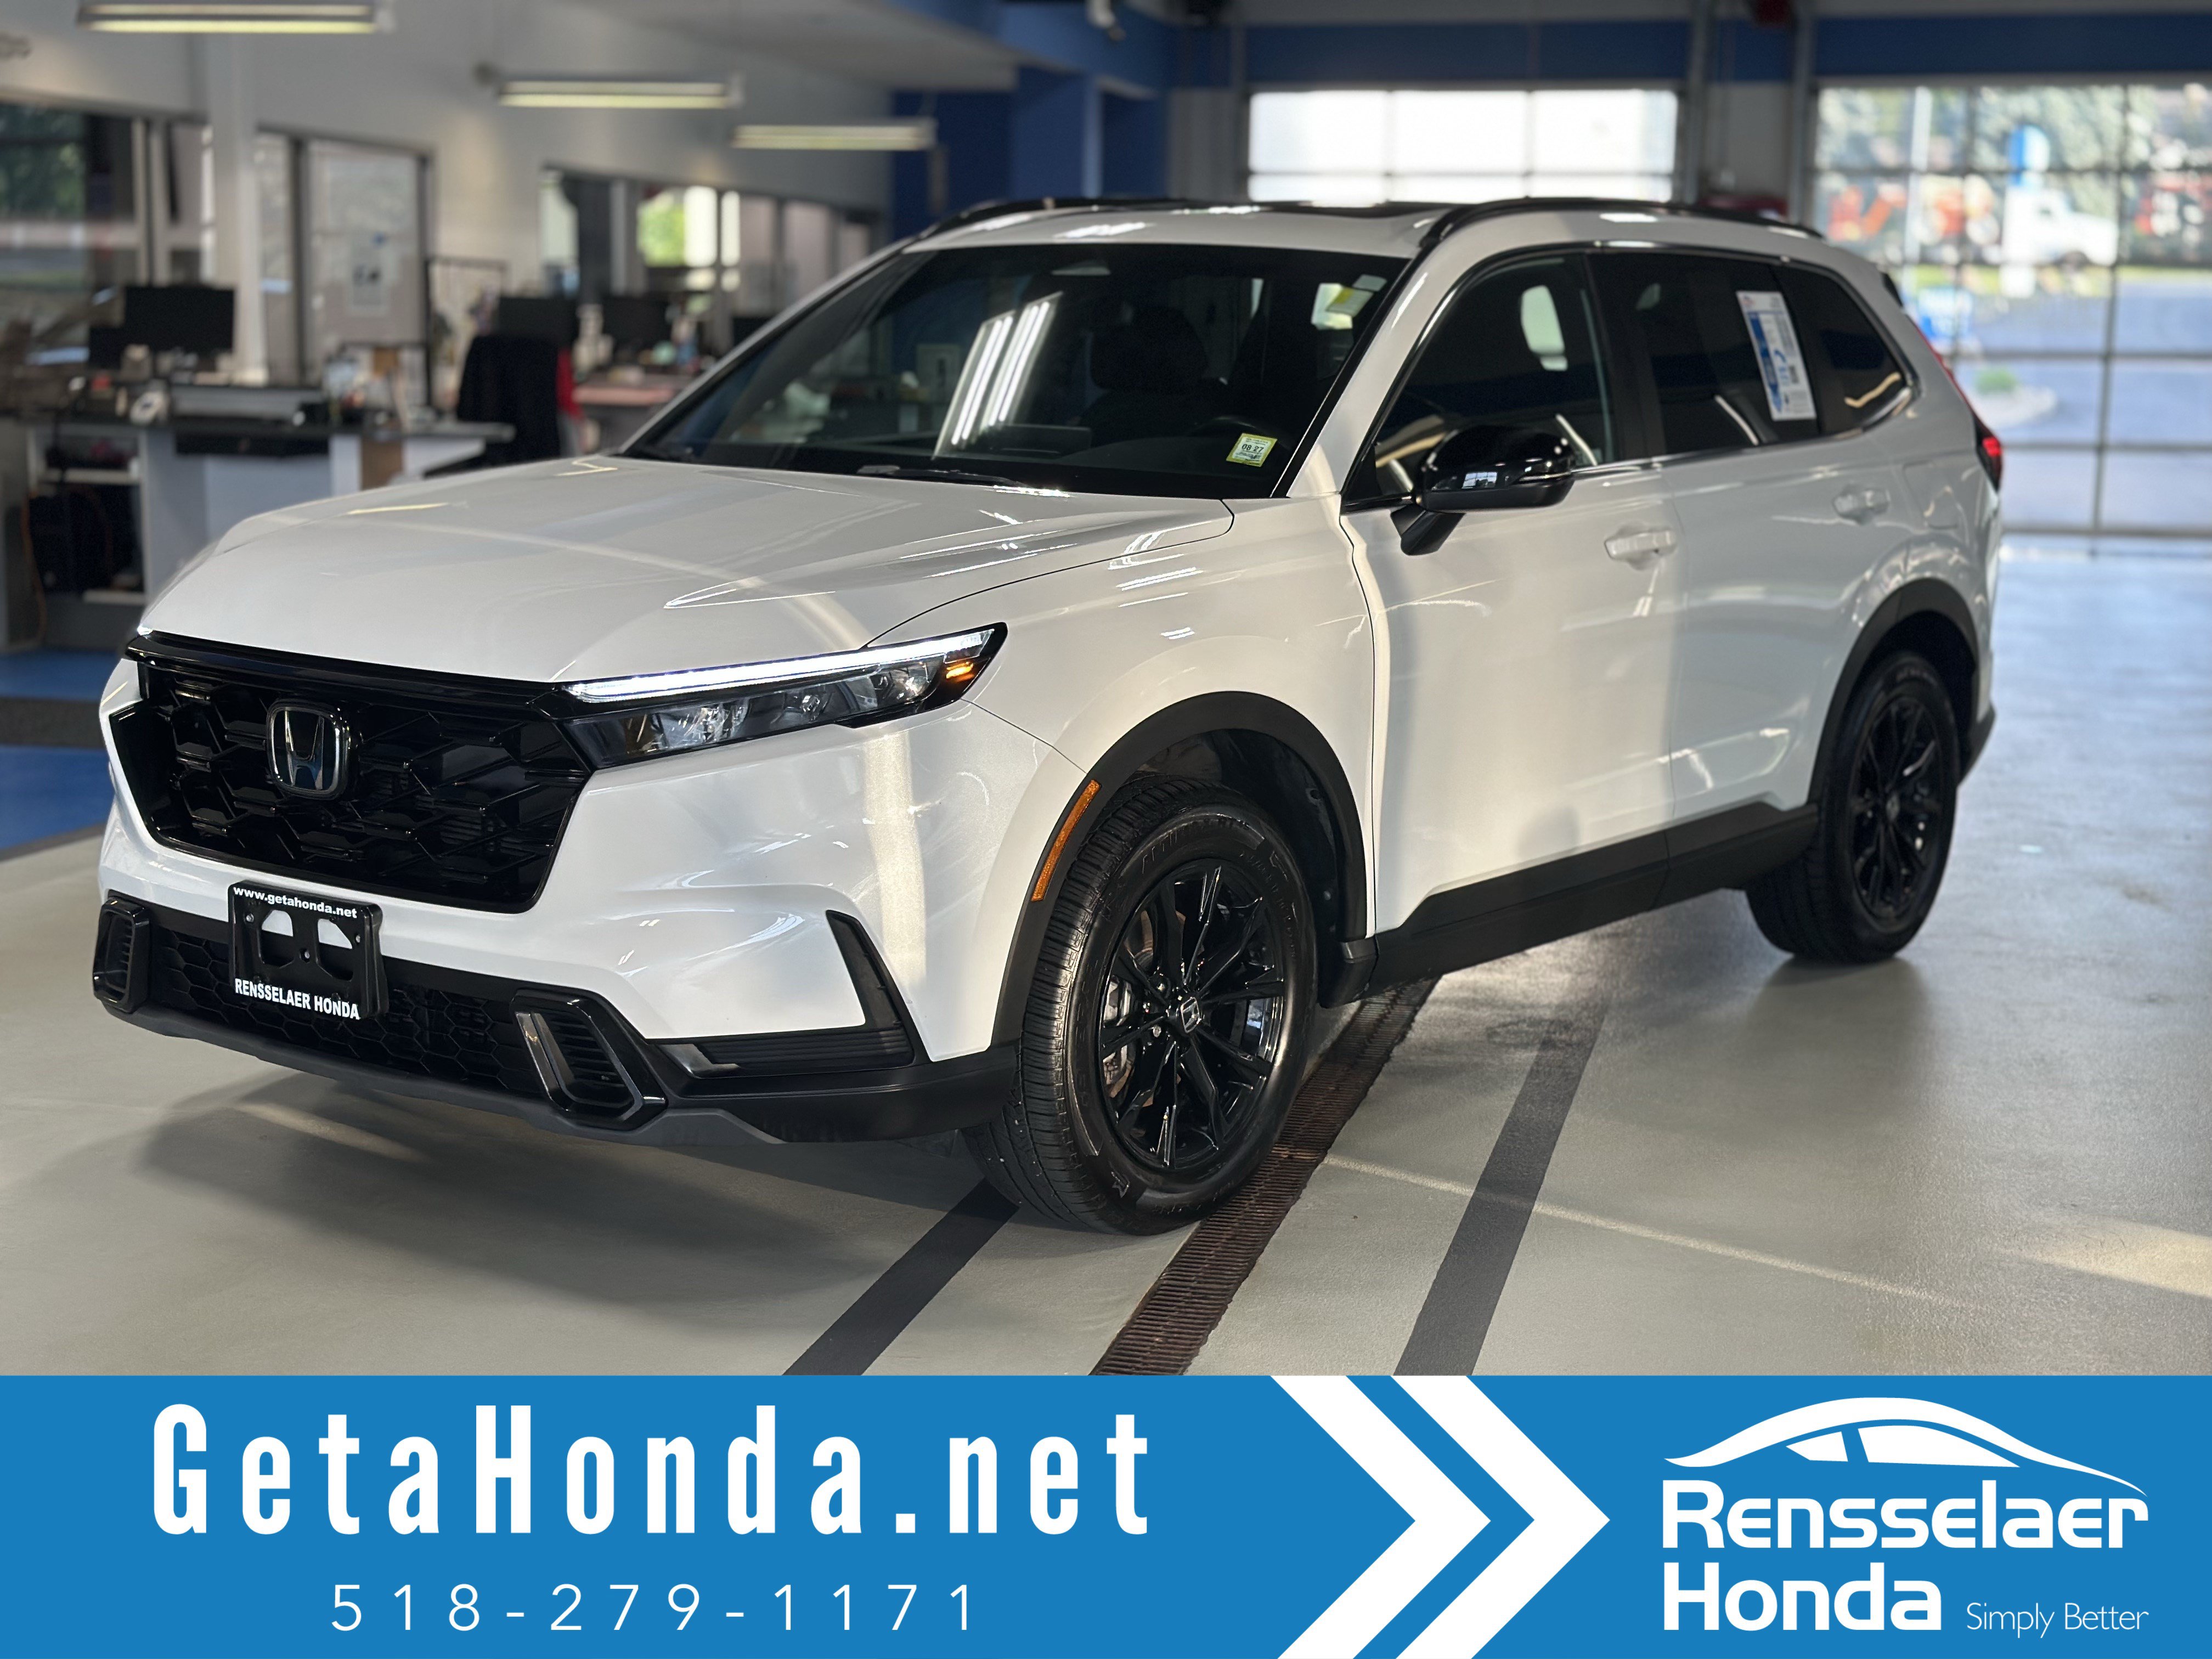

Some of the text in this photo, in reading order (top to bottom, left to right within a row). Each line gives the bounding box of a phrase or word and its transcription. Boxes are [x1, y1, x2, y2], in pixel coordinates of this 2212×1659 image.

[233, 887, 357, 918] www.getahonda.net
[235, 978, 360, 1020] RENSSELAER HONDA
